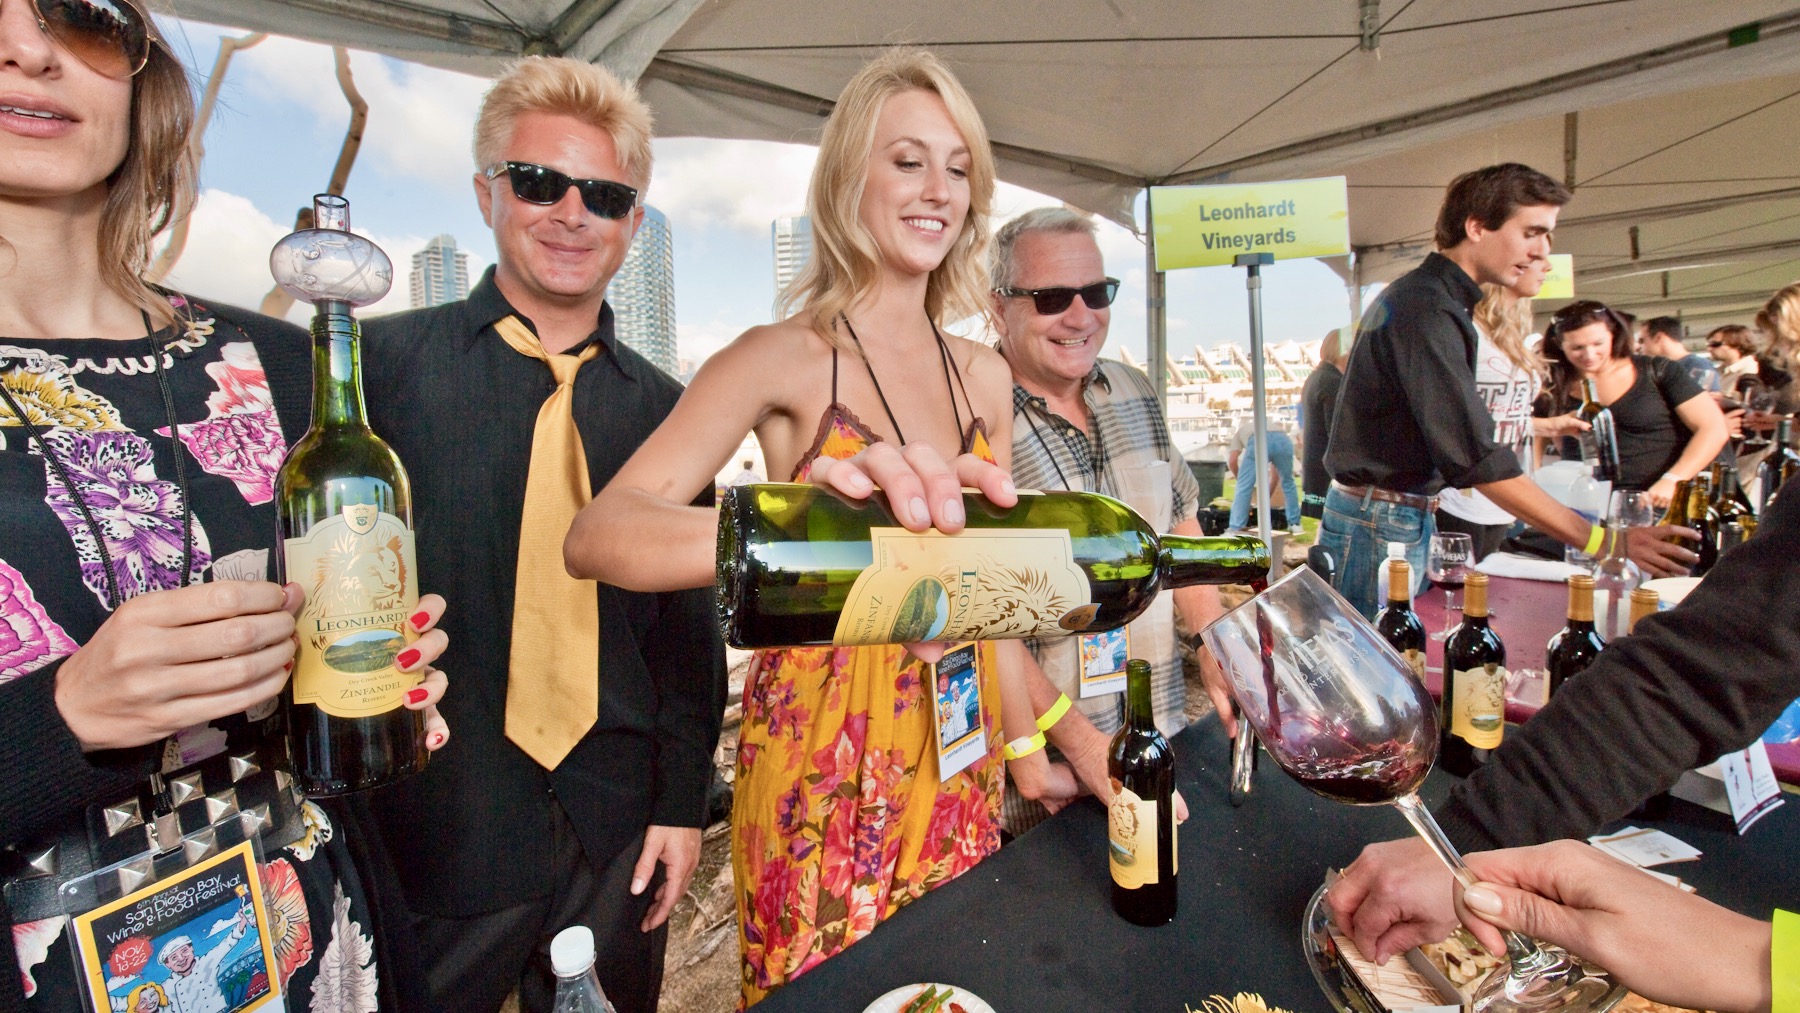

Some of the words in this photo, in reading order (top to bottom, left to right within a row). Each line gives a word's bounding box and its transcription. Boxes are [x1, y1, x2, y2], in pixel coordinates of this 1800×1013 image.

[1199, 200, 1296, 222] Leonhardt
[1201, 227, 1297, 251] Vineyards
[315, 611, 409, 633] LEONHARDT
[340, 681, 403, 700] ZINFANDEL
[125, 906, 153, 924] San
[154, 887, 195, 912] Diego
[196, 873, 222, 892] Bay
[106, 921, 145, 944] Wine
[157, 898, 195, 922] Food
[117, 952, 148, 973] 18-22
